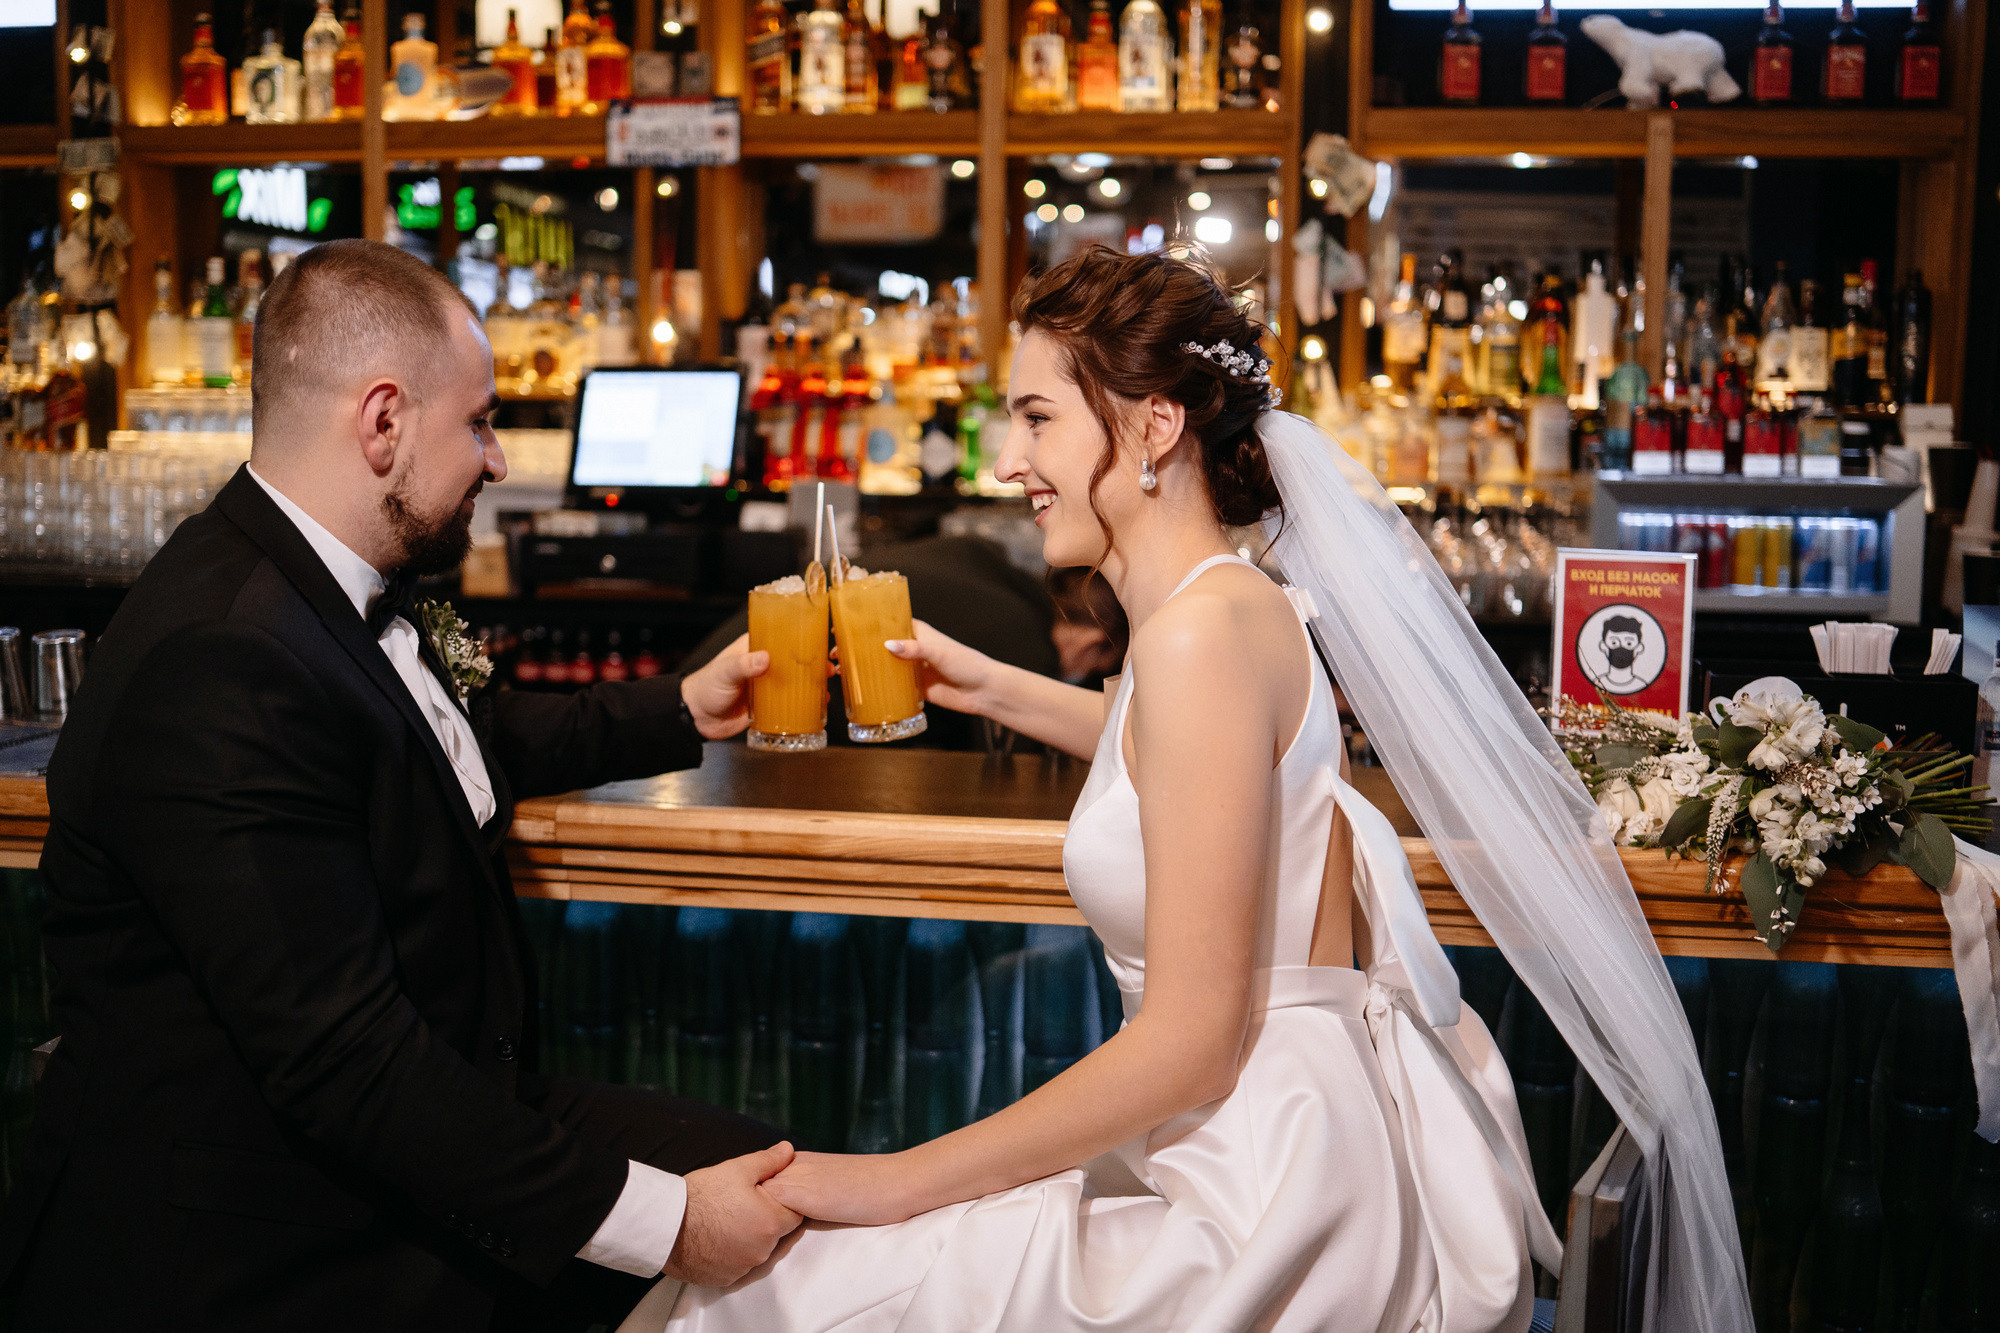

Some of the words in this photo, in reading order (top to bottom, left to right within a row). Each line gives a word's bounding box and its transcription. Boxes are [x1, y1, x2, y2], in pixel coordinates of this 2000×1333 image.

[1570, 569, 1605, 583] ВХОД
[1607, 570, 1630, 583] БЕЗ
[1632, 571, 1679, 585] МАСОК
[1589, 584, 1598, 596] И
[1600, 585, 1662, 599] ПЕРЧАТОК
